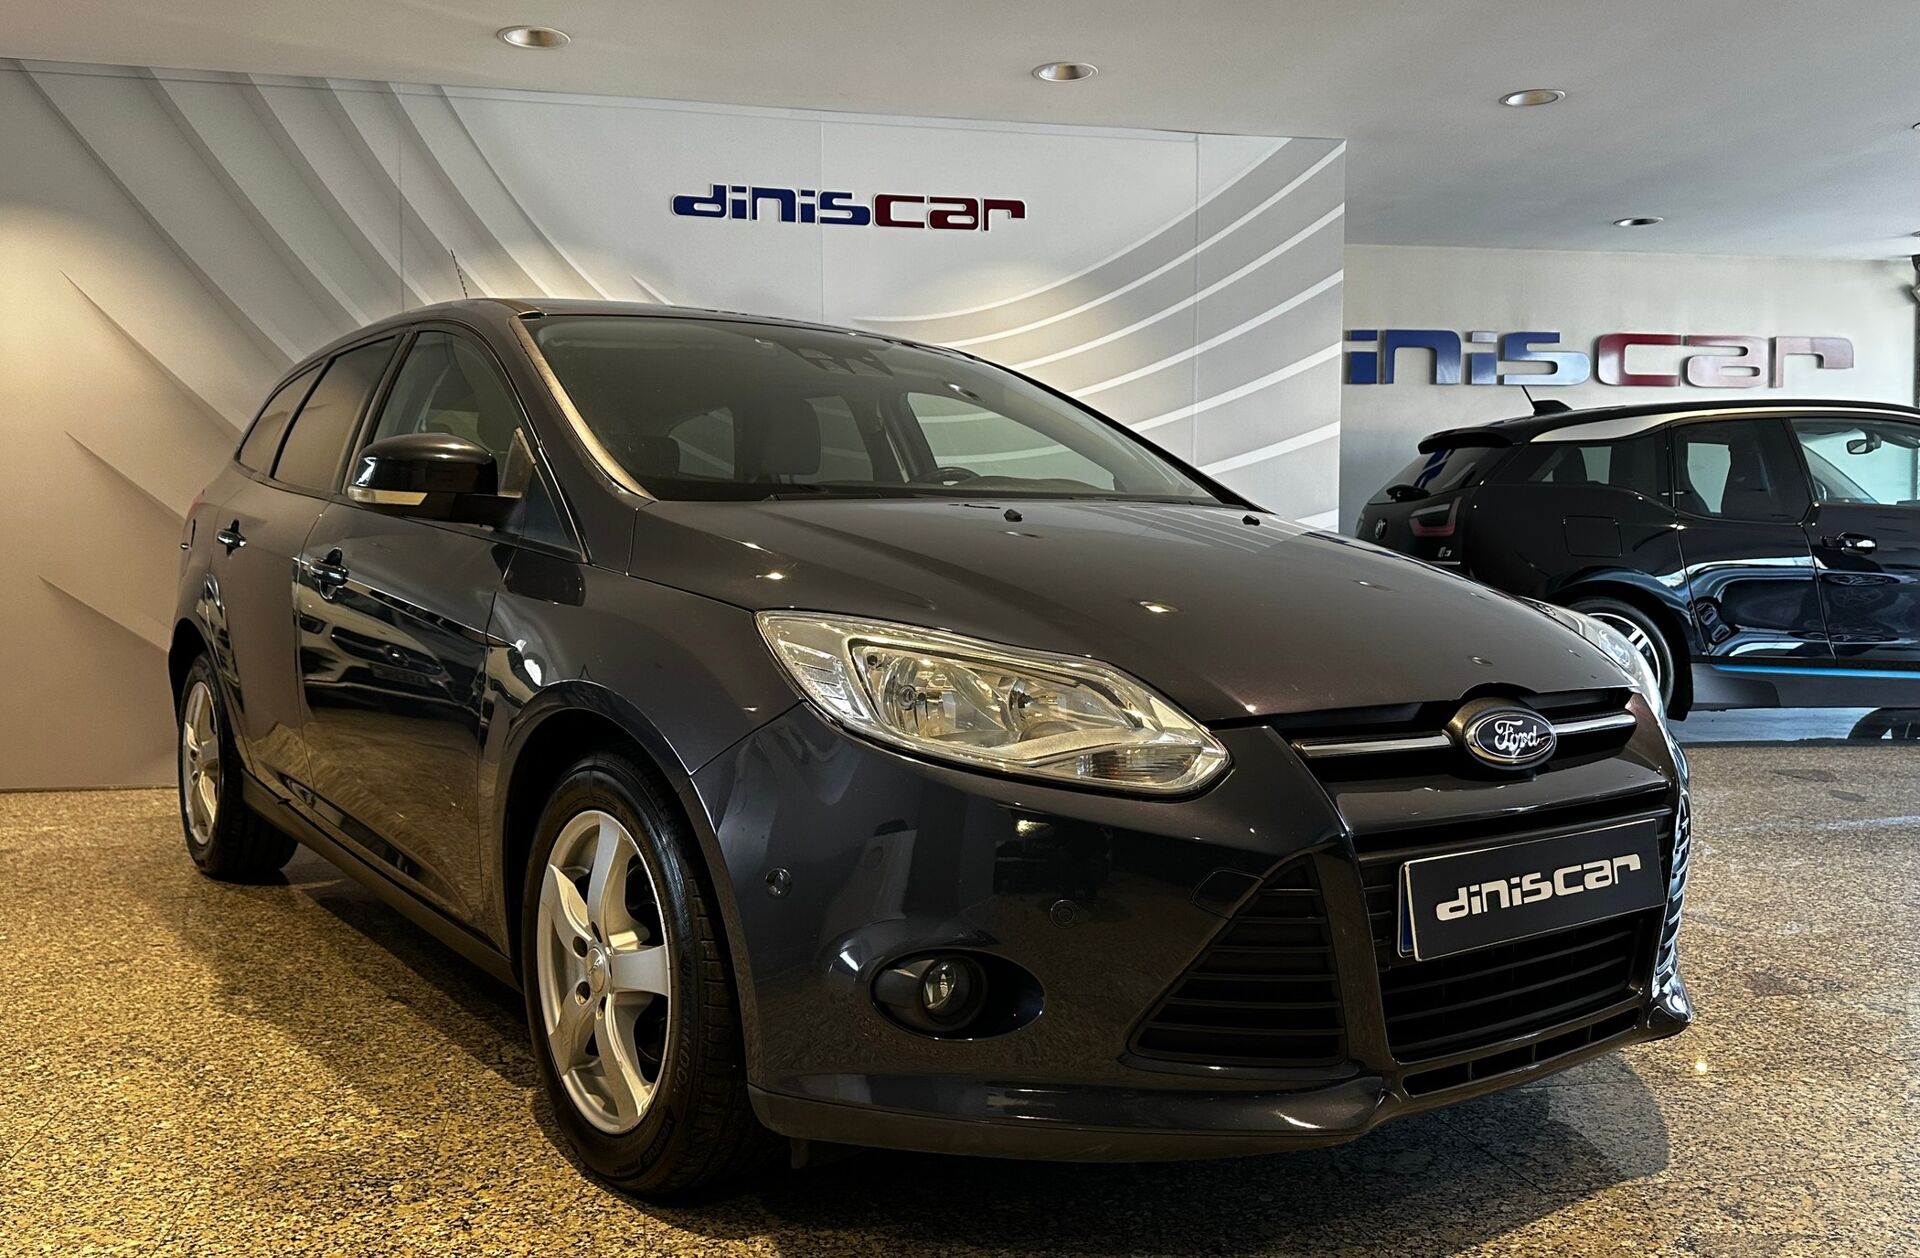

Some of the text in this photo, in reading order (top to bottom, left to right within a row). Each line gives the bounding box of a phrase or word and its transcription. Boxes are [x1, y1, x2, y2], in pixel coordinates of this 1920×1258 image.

[671, 183, 1026, 232] diniscar
[1494, 720, 1540, 753] Ford
[1435, 853, 1642, 922] diniscar
